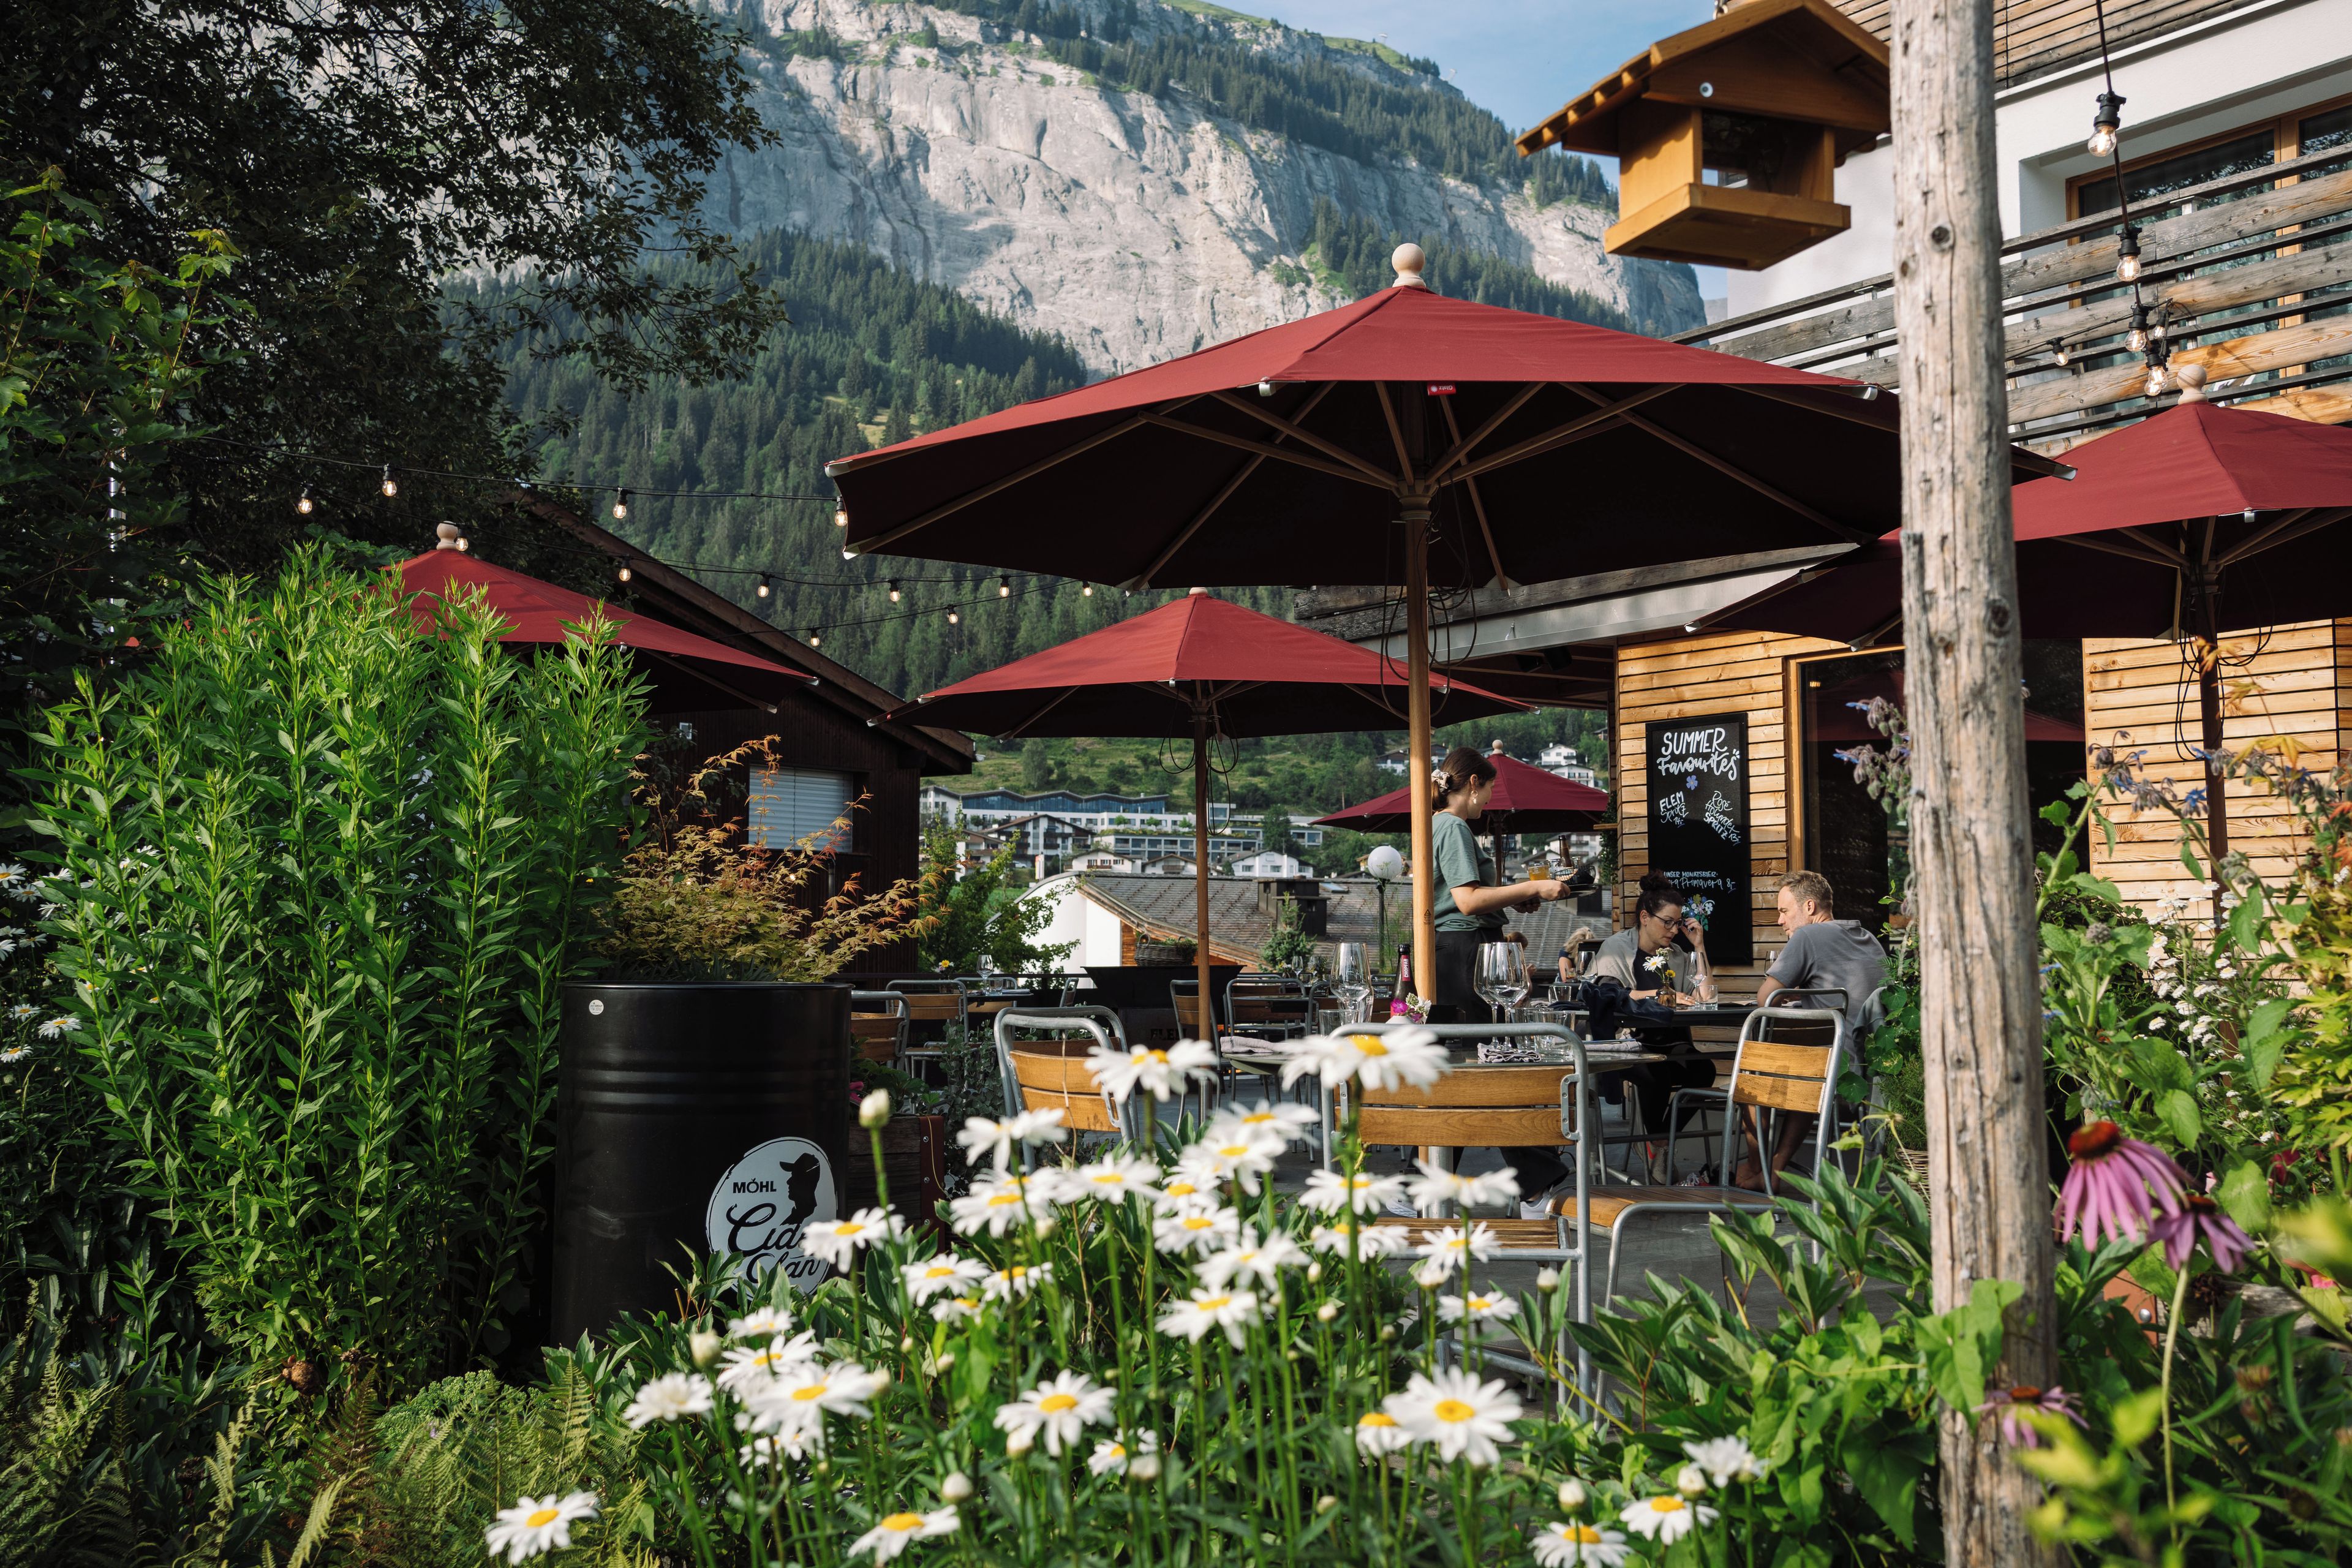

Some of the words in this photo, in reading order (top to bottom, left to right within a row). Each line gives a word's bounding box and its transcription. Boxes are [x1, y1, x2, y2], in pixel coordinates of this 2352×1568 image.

[1661, 727, 1728, 755] SUMMER
[1656, 751, 1737, 781] Favourites
[1659, 791, 1684, 812] FLEM
[1660, 802, 1689, 823] Spritz
[1703, 812, 1728, 840] SPRITZ
[1679, 877, 1724, 890] Primavera
[733, 1178, 777, 1194] MÖHL
